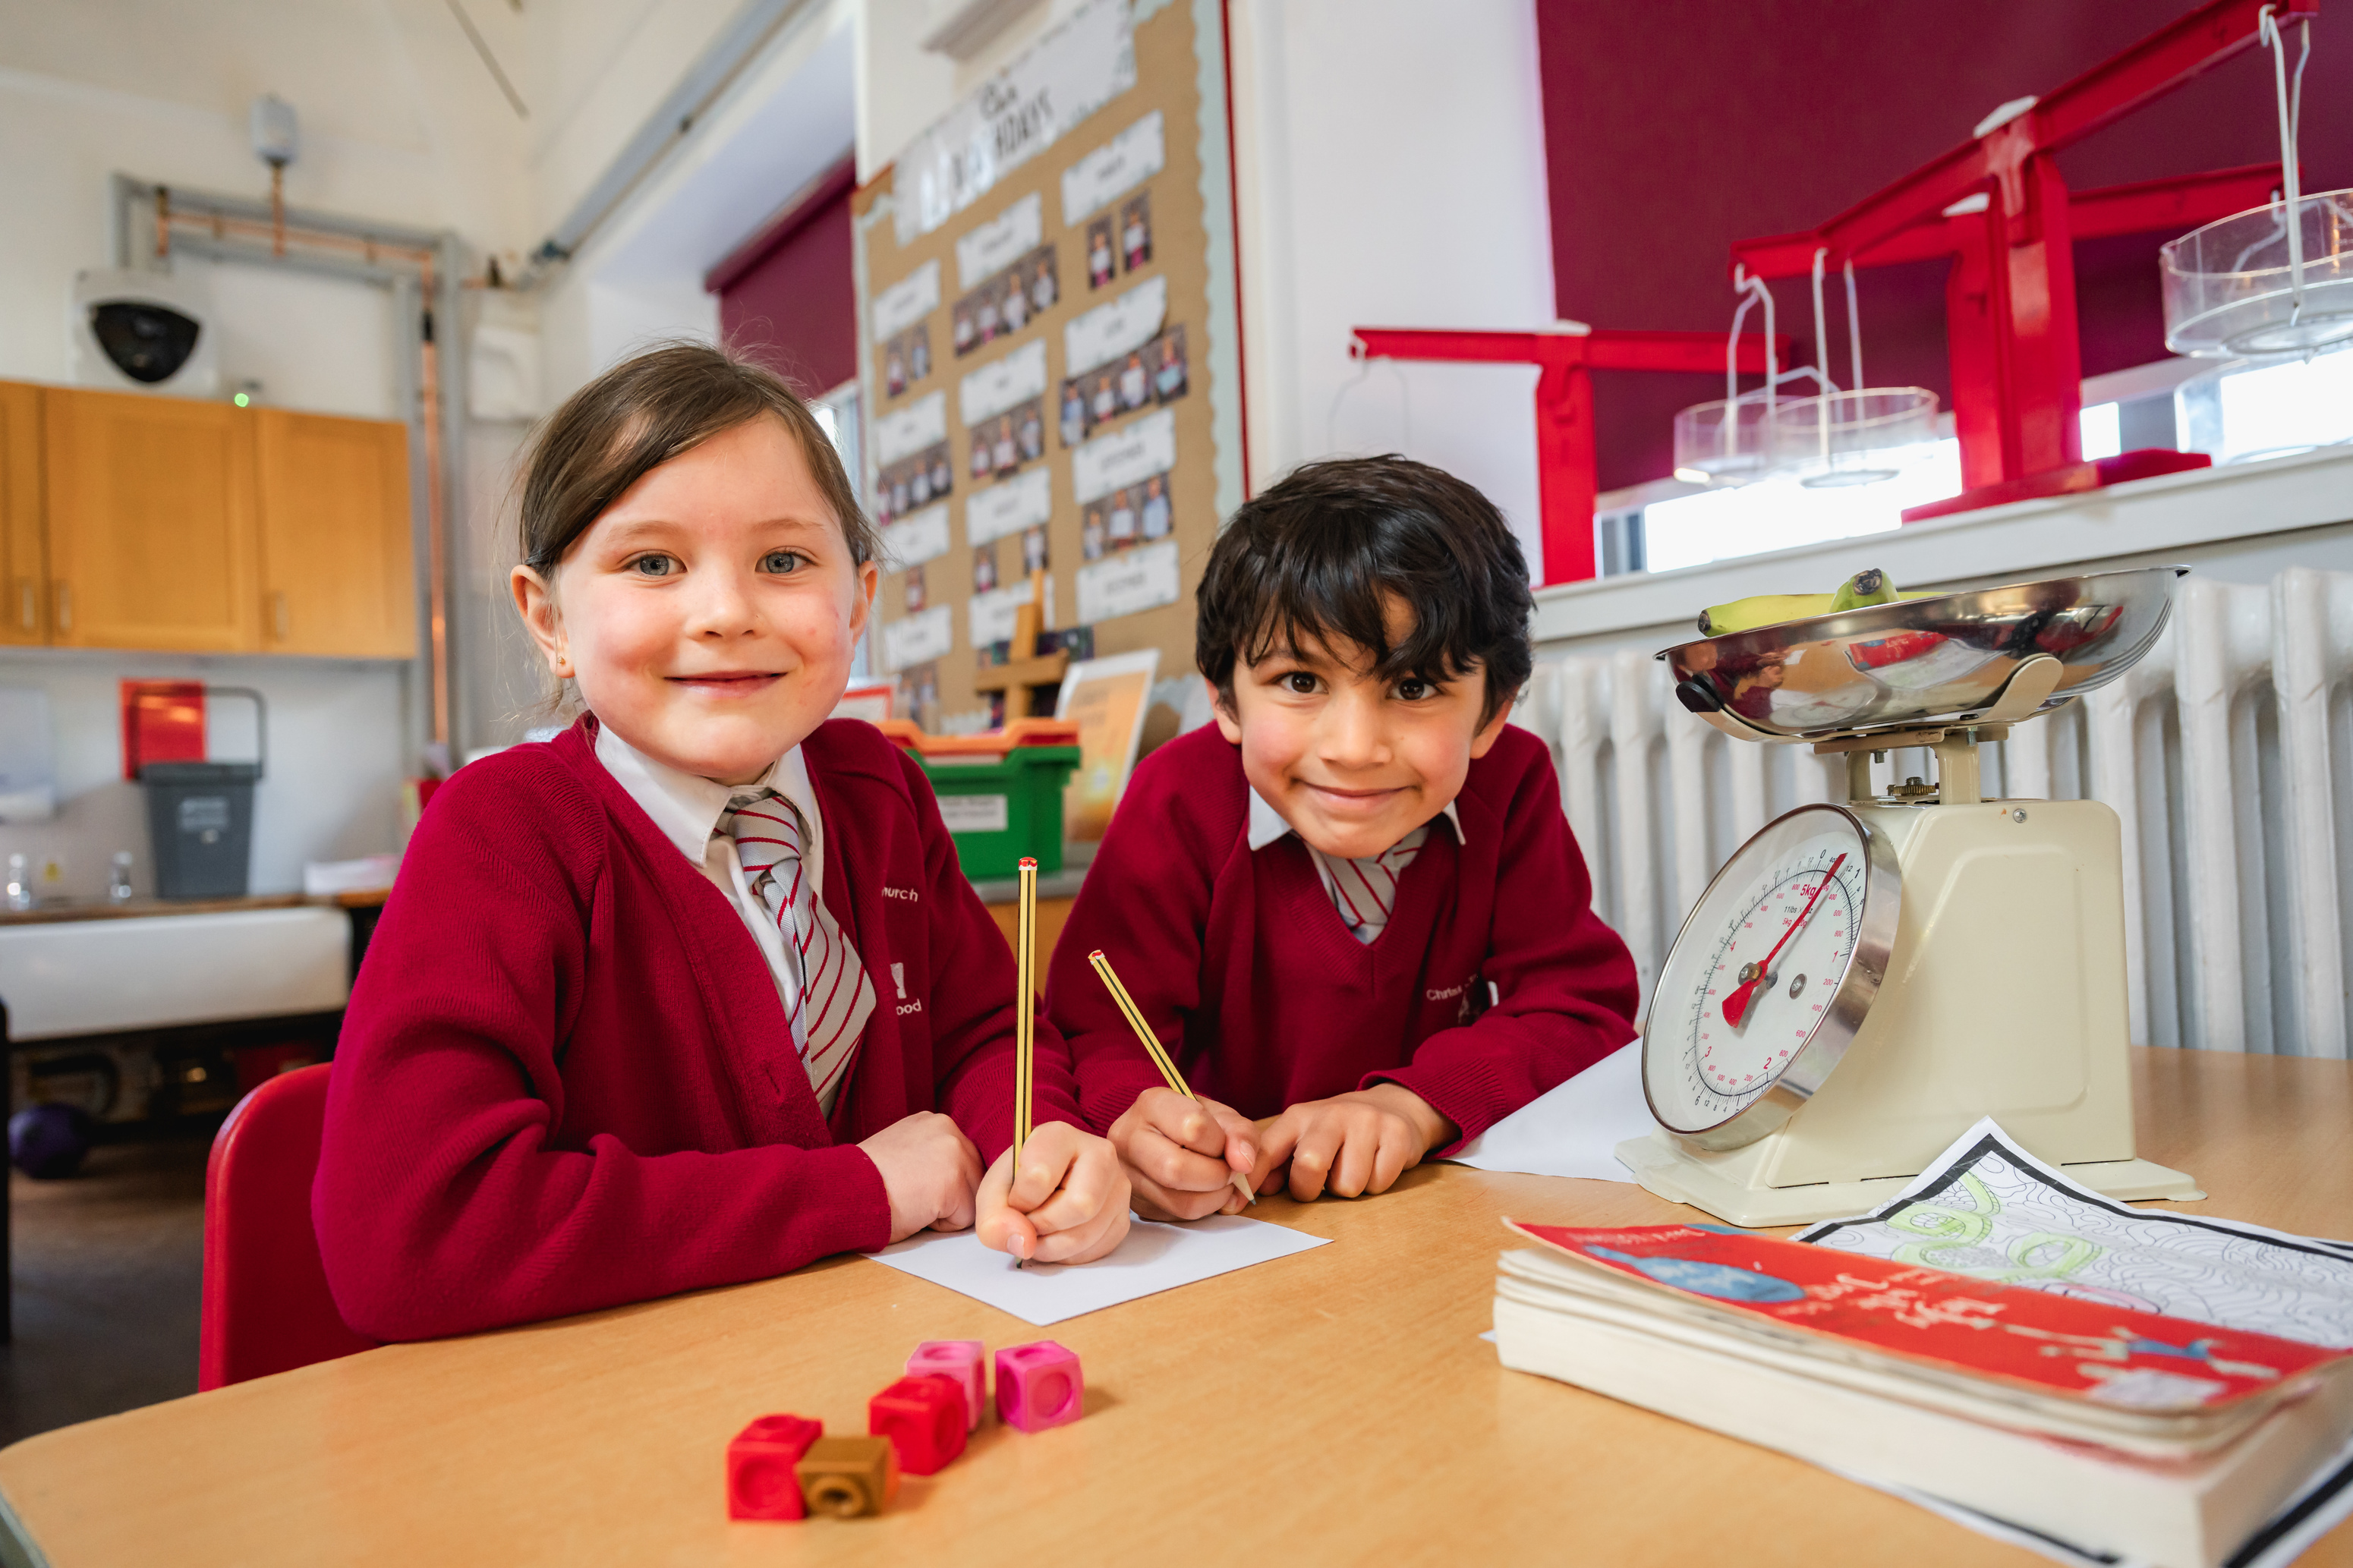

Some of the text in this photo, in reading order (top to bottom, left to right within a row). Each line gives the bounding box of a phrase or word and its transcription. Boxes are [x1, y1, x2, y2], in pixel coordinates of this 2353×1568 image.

[1820, 849, 1826, 858] 0
[1800, 884, 1816, 899] 5kg
[1782, 918, 1792, 927] 5kg
[1731, 941, 1736, 952] 4
[1832, 950, 1838, 962] 1
[1796, 1029, 1806, 1037] 600
[1705, 1046, 1712, 1057] 3
[1763, 1057, 1772, 1069] 2
[1695, 1095, 1700, 1105] 6
